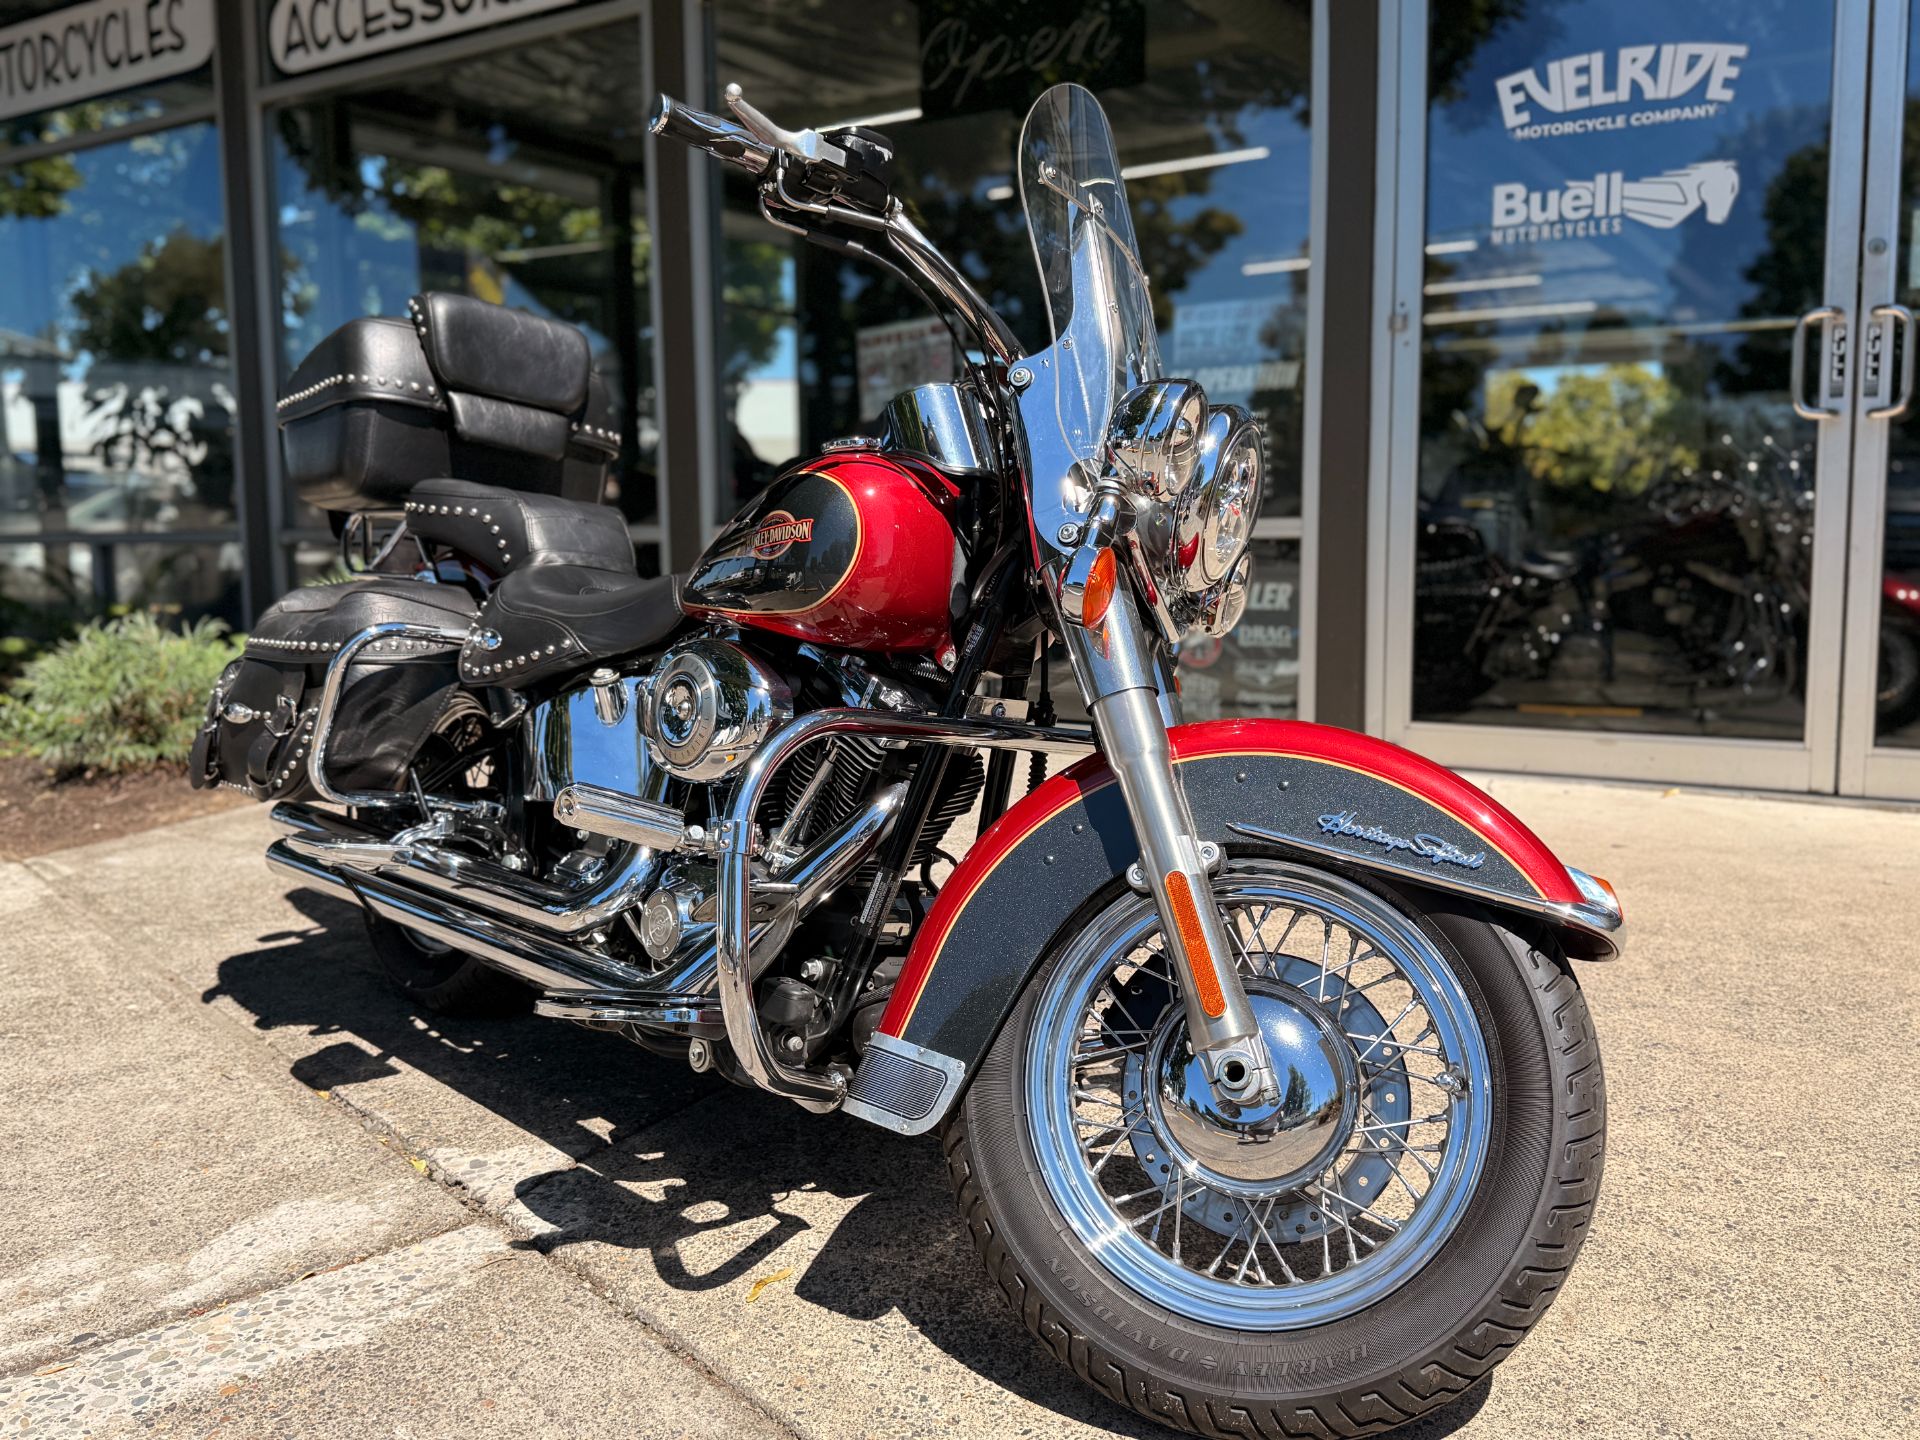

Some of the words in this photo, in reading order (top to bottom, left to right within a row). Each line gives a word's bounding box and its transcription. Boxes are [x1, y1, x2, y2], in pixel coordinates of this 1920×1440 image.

[0, 0, 186, 98] TORCYCLES
[922, 16, 1122, 107] Open
[1496, 43, 1749, 129] EVELRIDE
[1514, 114, 1627, 141] MOTORCYCLE
[1630, 103, 1718, 127] COMPANY
[1492, 171, 1623, 228] Buell
[1490, 217, 1623, 245] MOTORCYCLES
[1832, 327, 1846, 381] PULL
[1866, 325, 1881, 381] PULL
